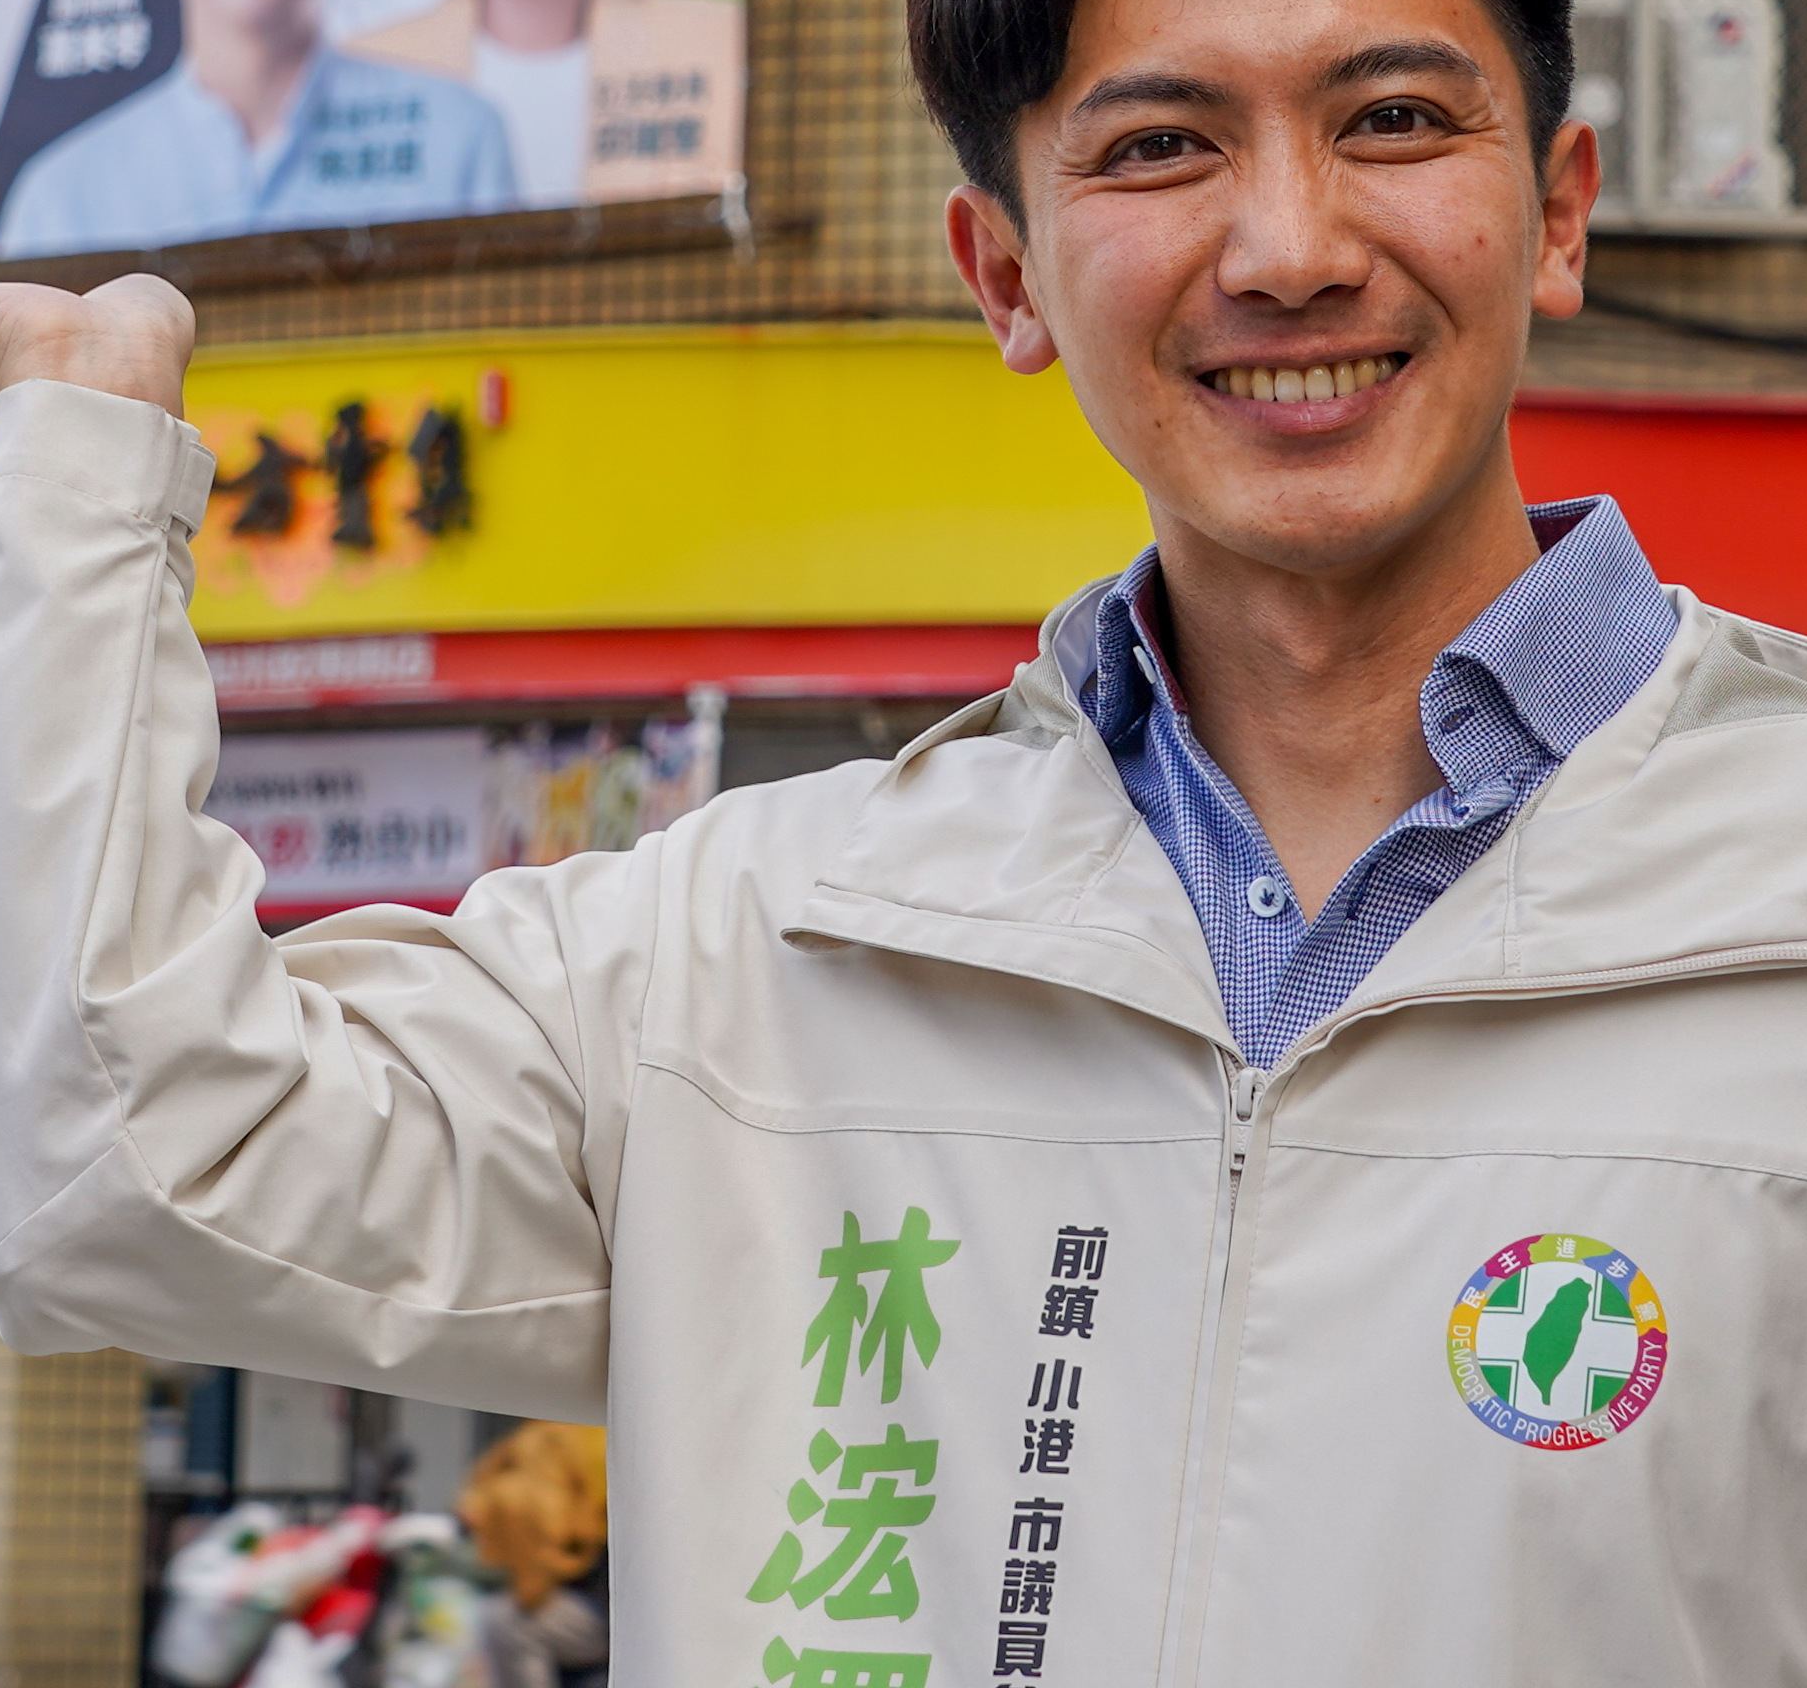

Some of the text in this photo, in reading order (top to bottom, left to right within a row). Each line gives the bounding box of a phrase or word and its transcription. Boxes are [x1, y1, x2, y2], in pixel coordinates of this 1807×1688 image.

[211, 397, 480, 552] 方雲集
[1461, 1236, 1660, 1323] 民主進步黨
[1451, 1323, 1664, 1447] DEMOCRATIC PROGRESSIVE PARTY
[992, 1224, 1110, 1688] 前鎮 小港 市議員
